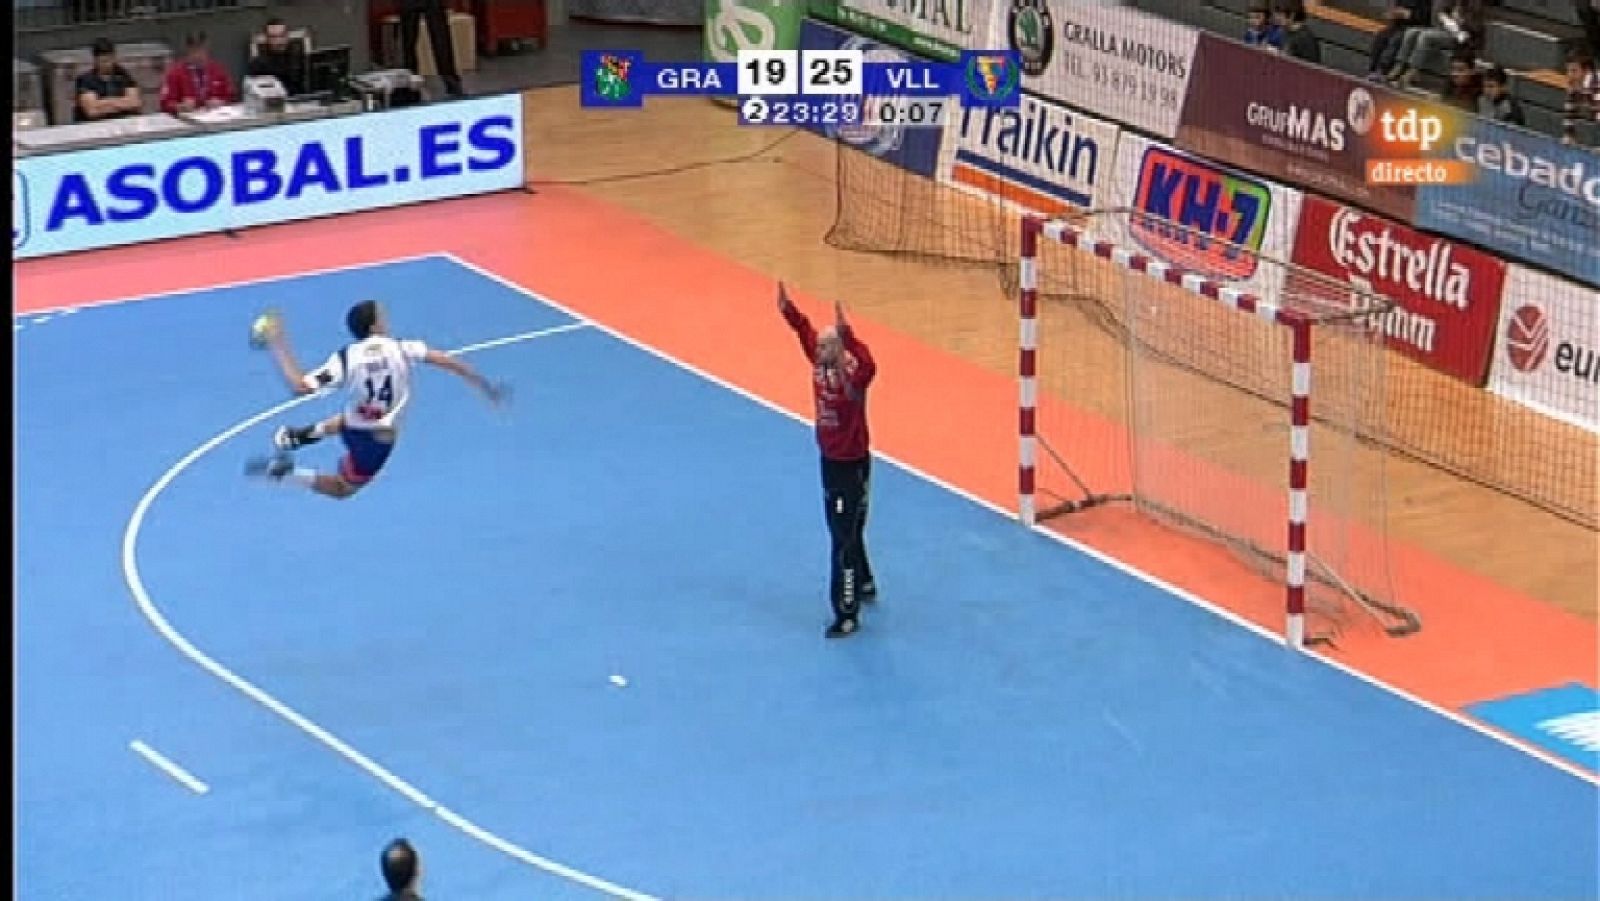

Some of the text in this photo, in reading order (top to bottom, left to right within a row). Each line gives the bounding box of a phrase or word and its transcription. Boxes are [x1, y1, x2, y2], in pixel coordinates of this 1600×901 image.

[1064, 21, 1187, 79] GRALLA MOTORS
[45, 115, 517, 232] ASOBAL.ES
[1329, 206, 1471, 311] Estrella
[364, 374, 393, 407] 14
